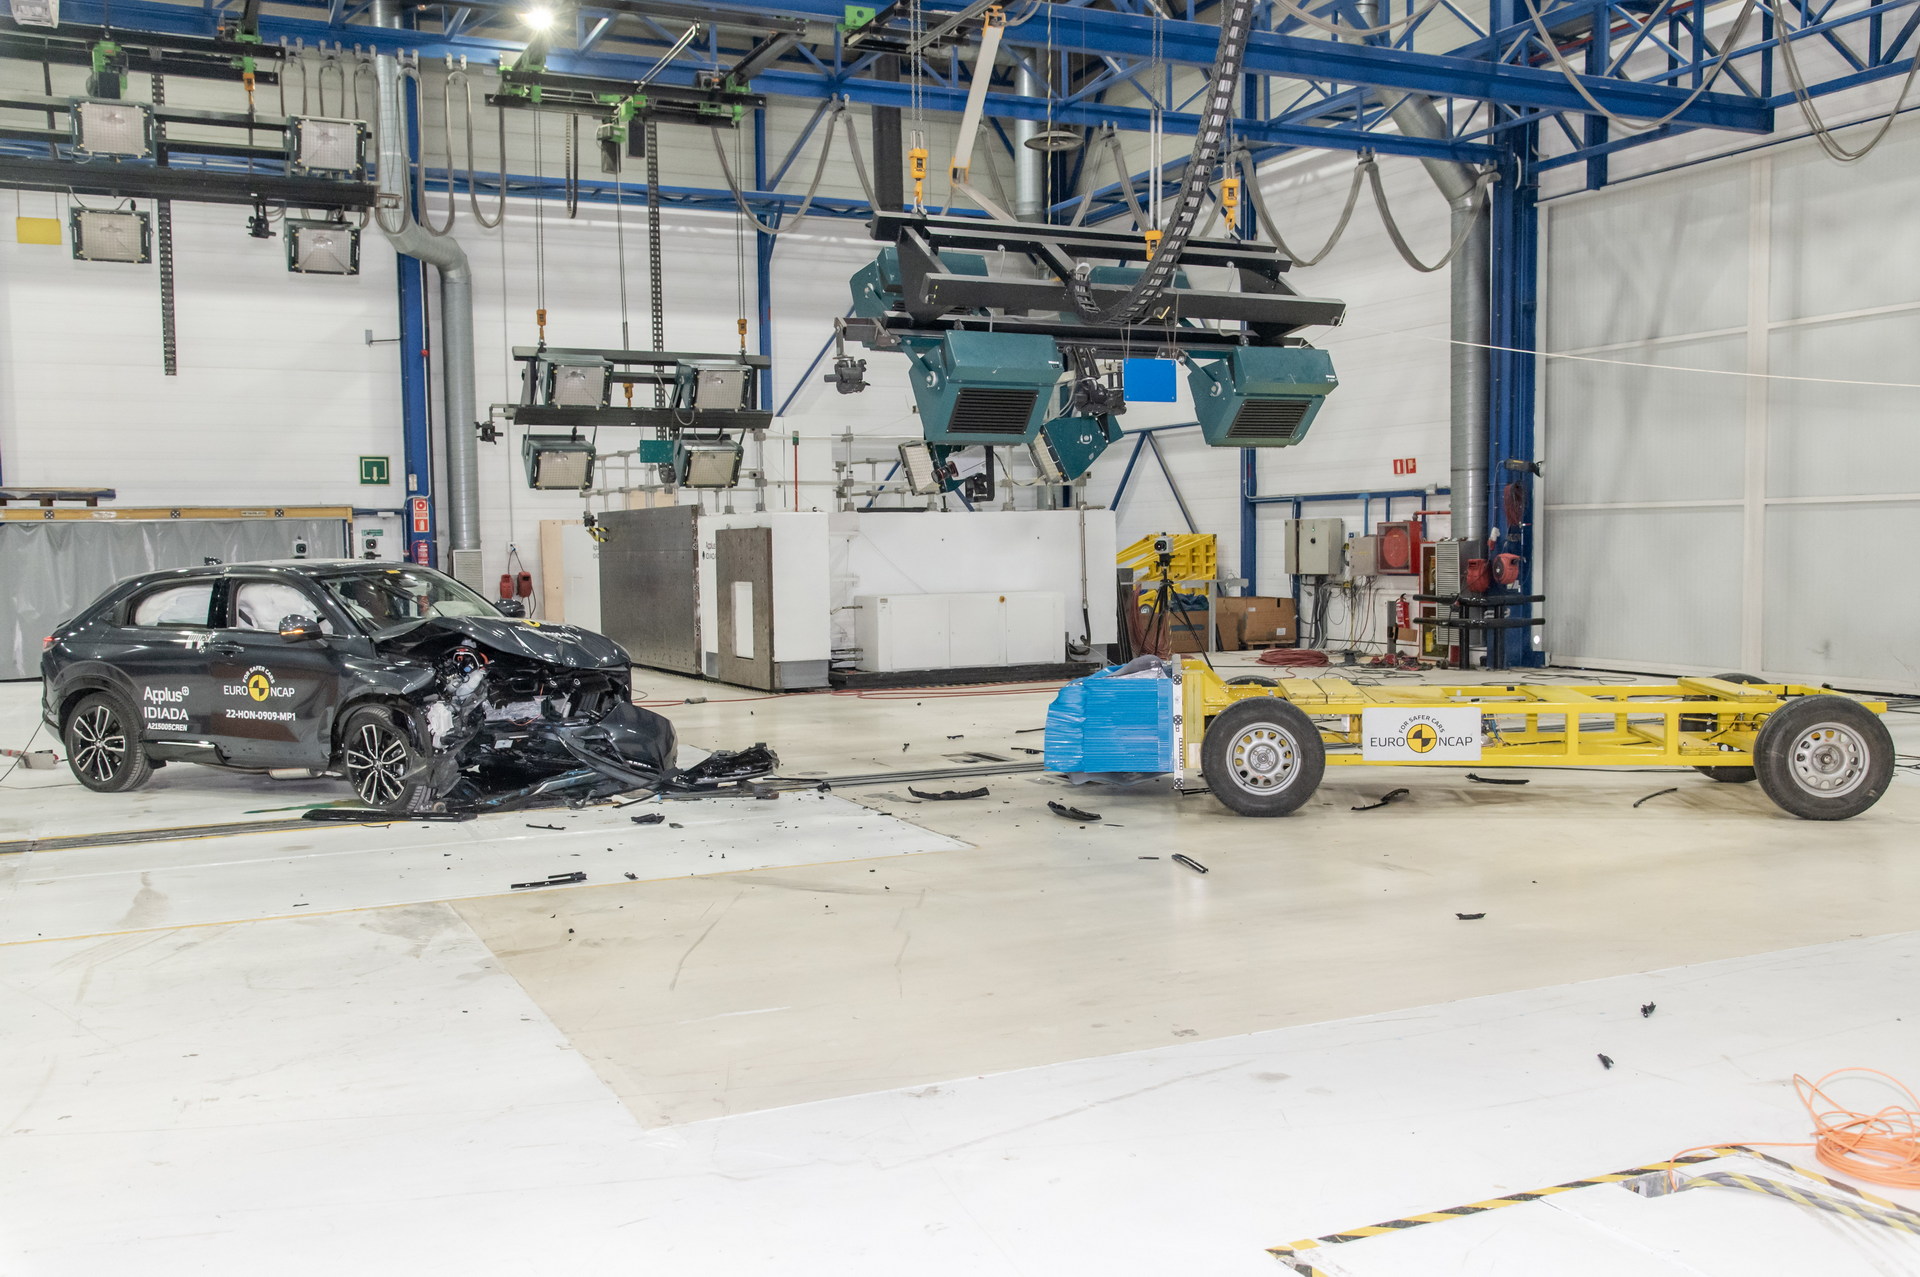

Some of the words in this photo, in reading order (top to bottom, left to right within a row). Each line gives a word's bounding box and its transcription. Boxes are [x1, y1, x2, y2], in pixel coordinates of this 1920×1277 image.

[242, 671, 251, 683] FOR
[249, 665, 265, 674] SAFER
[264, 670, 275, 684] CARS
[223, 685, 248, 696] EURO
[270, 687, 295, 698] NCAP
[144, 706, 189, 721] IDIADA
[225, 709, 296, 721] 22-HON-0909-MP1
[1398, 721, 1409, 733] FOR
[1408, 714, 1431, 723] SAFER
[1431, 718, 1445, 733] CARS
[1370, 737, 1406, 747] EURO
[1438, 736, 1473, 747] NCAP
